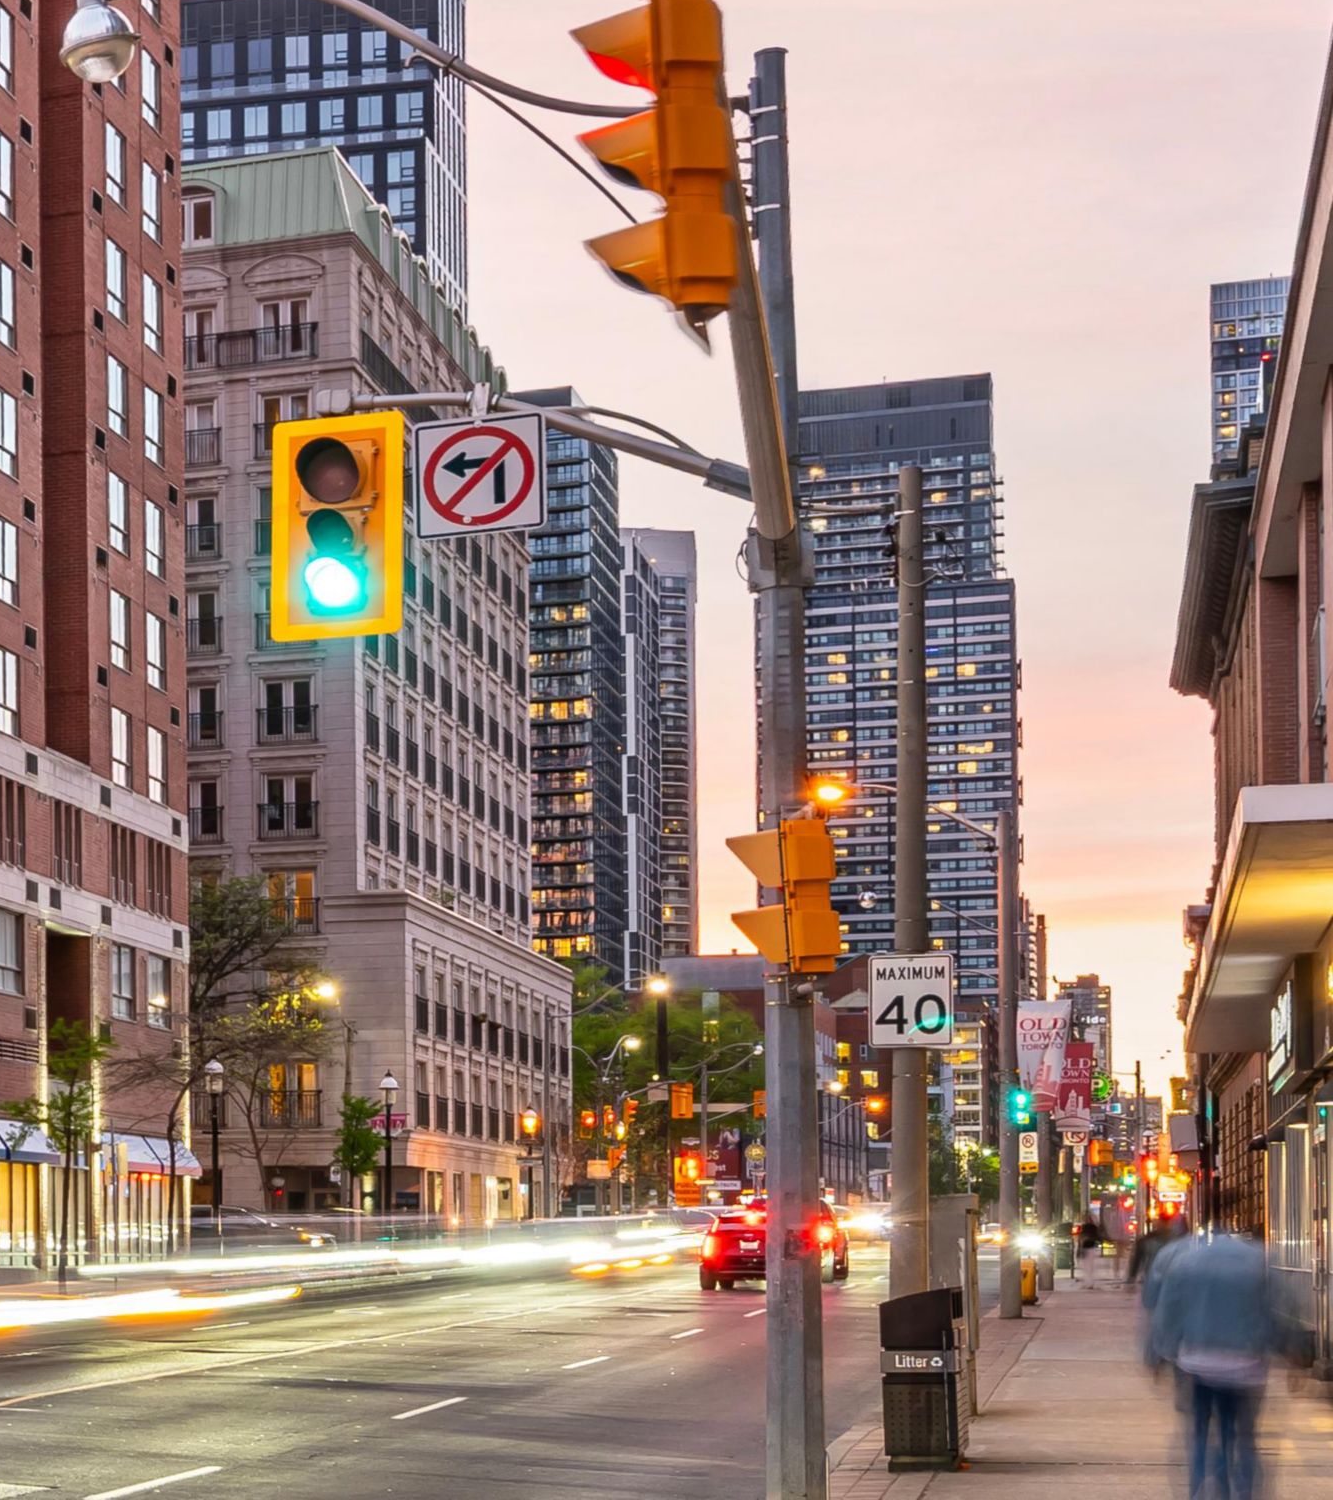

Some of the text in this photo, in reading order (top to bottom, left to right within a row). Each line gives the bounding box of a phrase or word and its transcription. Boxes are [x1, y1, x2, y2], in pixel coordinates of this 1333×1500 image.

[876, 966, 945, 980] MAXIMUM
[875, 994, 946, 1035] 40
[1020, 1018, 1067, 1031] OLD
[1019, 1032, 1065, 1042] TOWN
[1061, 1070, 1090, 1078] OWN
[895, 1355, 927, 1368] Litter
